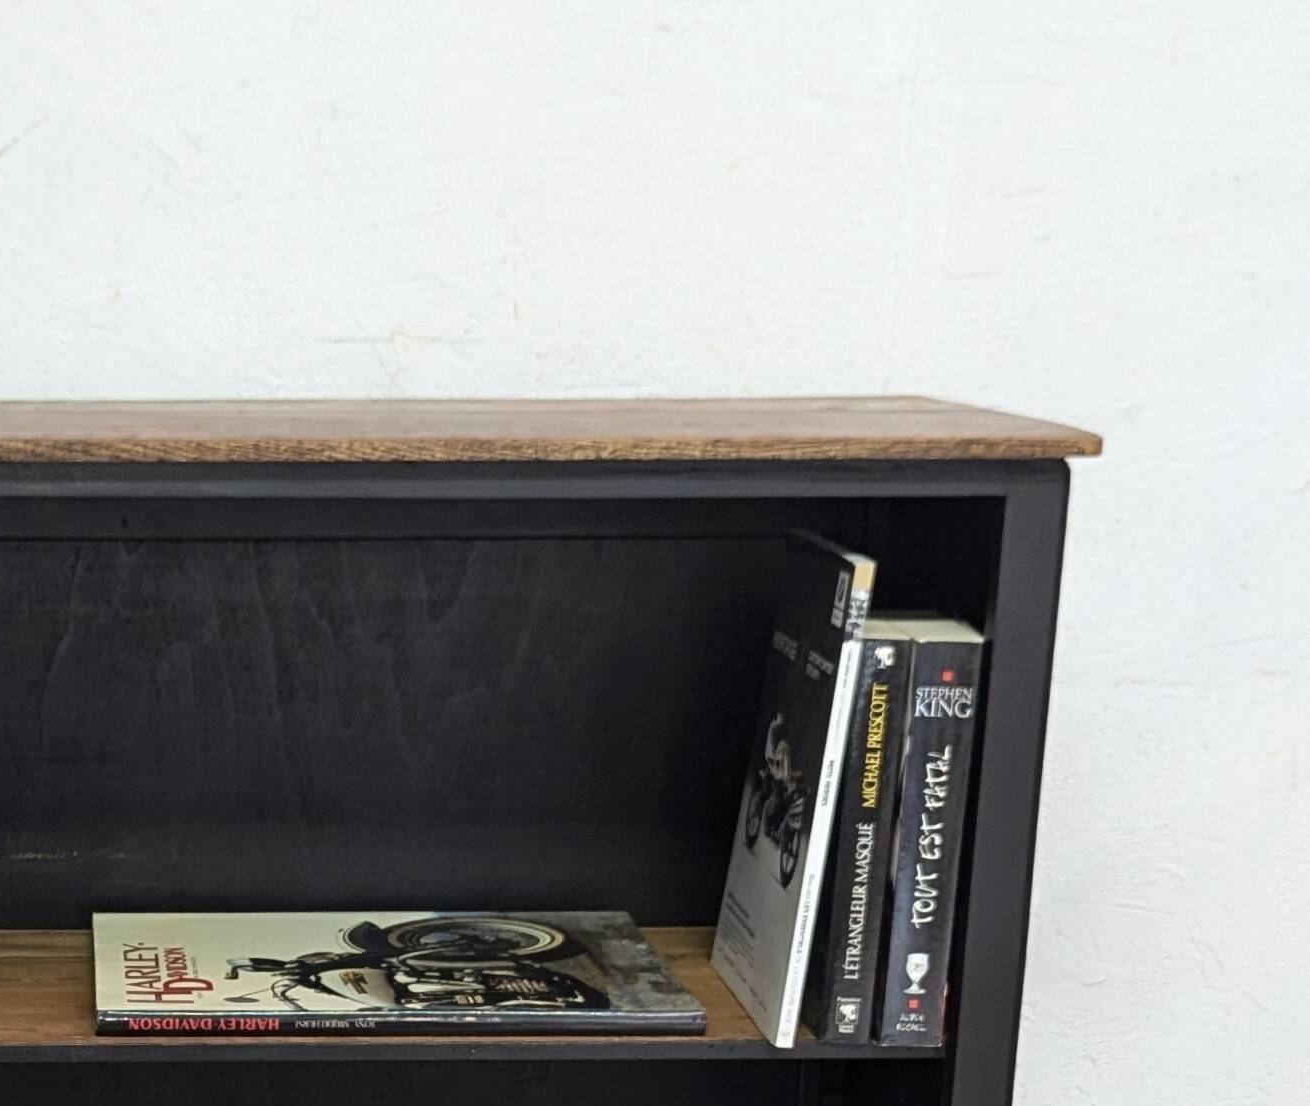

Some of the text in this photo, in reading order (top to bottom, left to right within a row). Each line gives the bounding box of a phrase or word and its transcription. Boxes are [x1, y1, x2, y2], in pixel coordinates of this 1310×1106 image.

[913, 698, 973, 718] KING
[915, 686, 973, 700] STEPHEN
[861, 682, 889, 808] MICHAEL PRESCOTT
[910, 744, 952, 928] TOUT EST FATAL
[843, 822, 874, 980] L'ÉTRANGLEUR MASQUÉ
[162, 946, 213, 992] DAVIDSON
[128, 1017, 280, 1031] HARLEY-DAVIDSON
